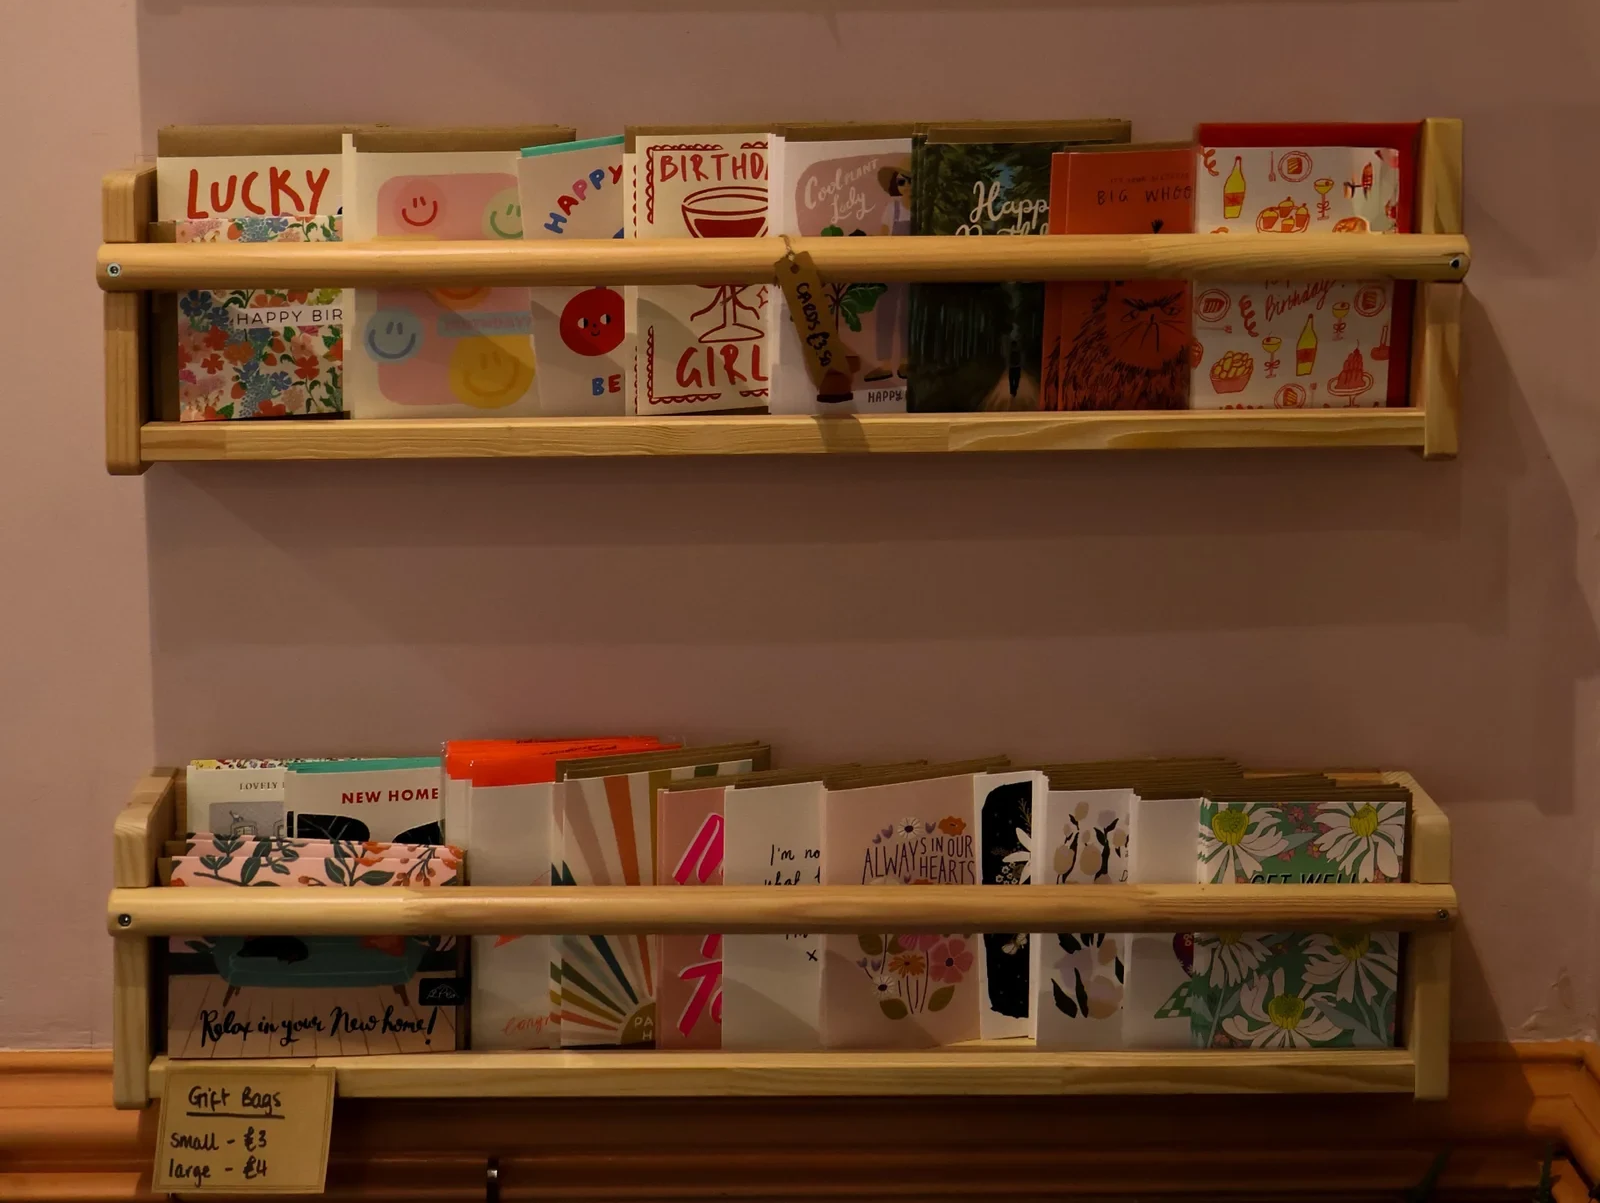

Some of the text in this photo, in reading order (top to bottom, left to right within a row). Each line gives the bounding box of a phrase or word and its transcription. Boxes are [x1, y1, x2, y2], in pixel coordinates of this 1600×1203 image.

[187, 166, 330, 219] LUCKY
[543, 164, 624, 234] HAPPY
[1096, 189, 1129, 206] BIG
[237, 311, 302, 325] HAPPY
[592, 374, 621, 396] BE
[868, 390, 903, 403] HAPPY
[239, 782, 278, 791] LOVELY
[341, 788, 439, 804] NEW HOME
[861, 835, 974, 885] ALWAYS IN OUR
[920, 855, 975, 885] HEARTS
[200, 1005, 438, 1047] Relax in your New home!
[188, 1085, 281, 1115] Gift Bags
[243, 1126, 267, 1152] £3
[168, 1158, 211, 1187] large
[243, 1155, 267, 1179] £4
